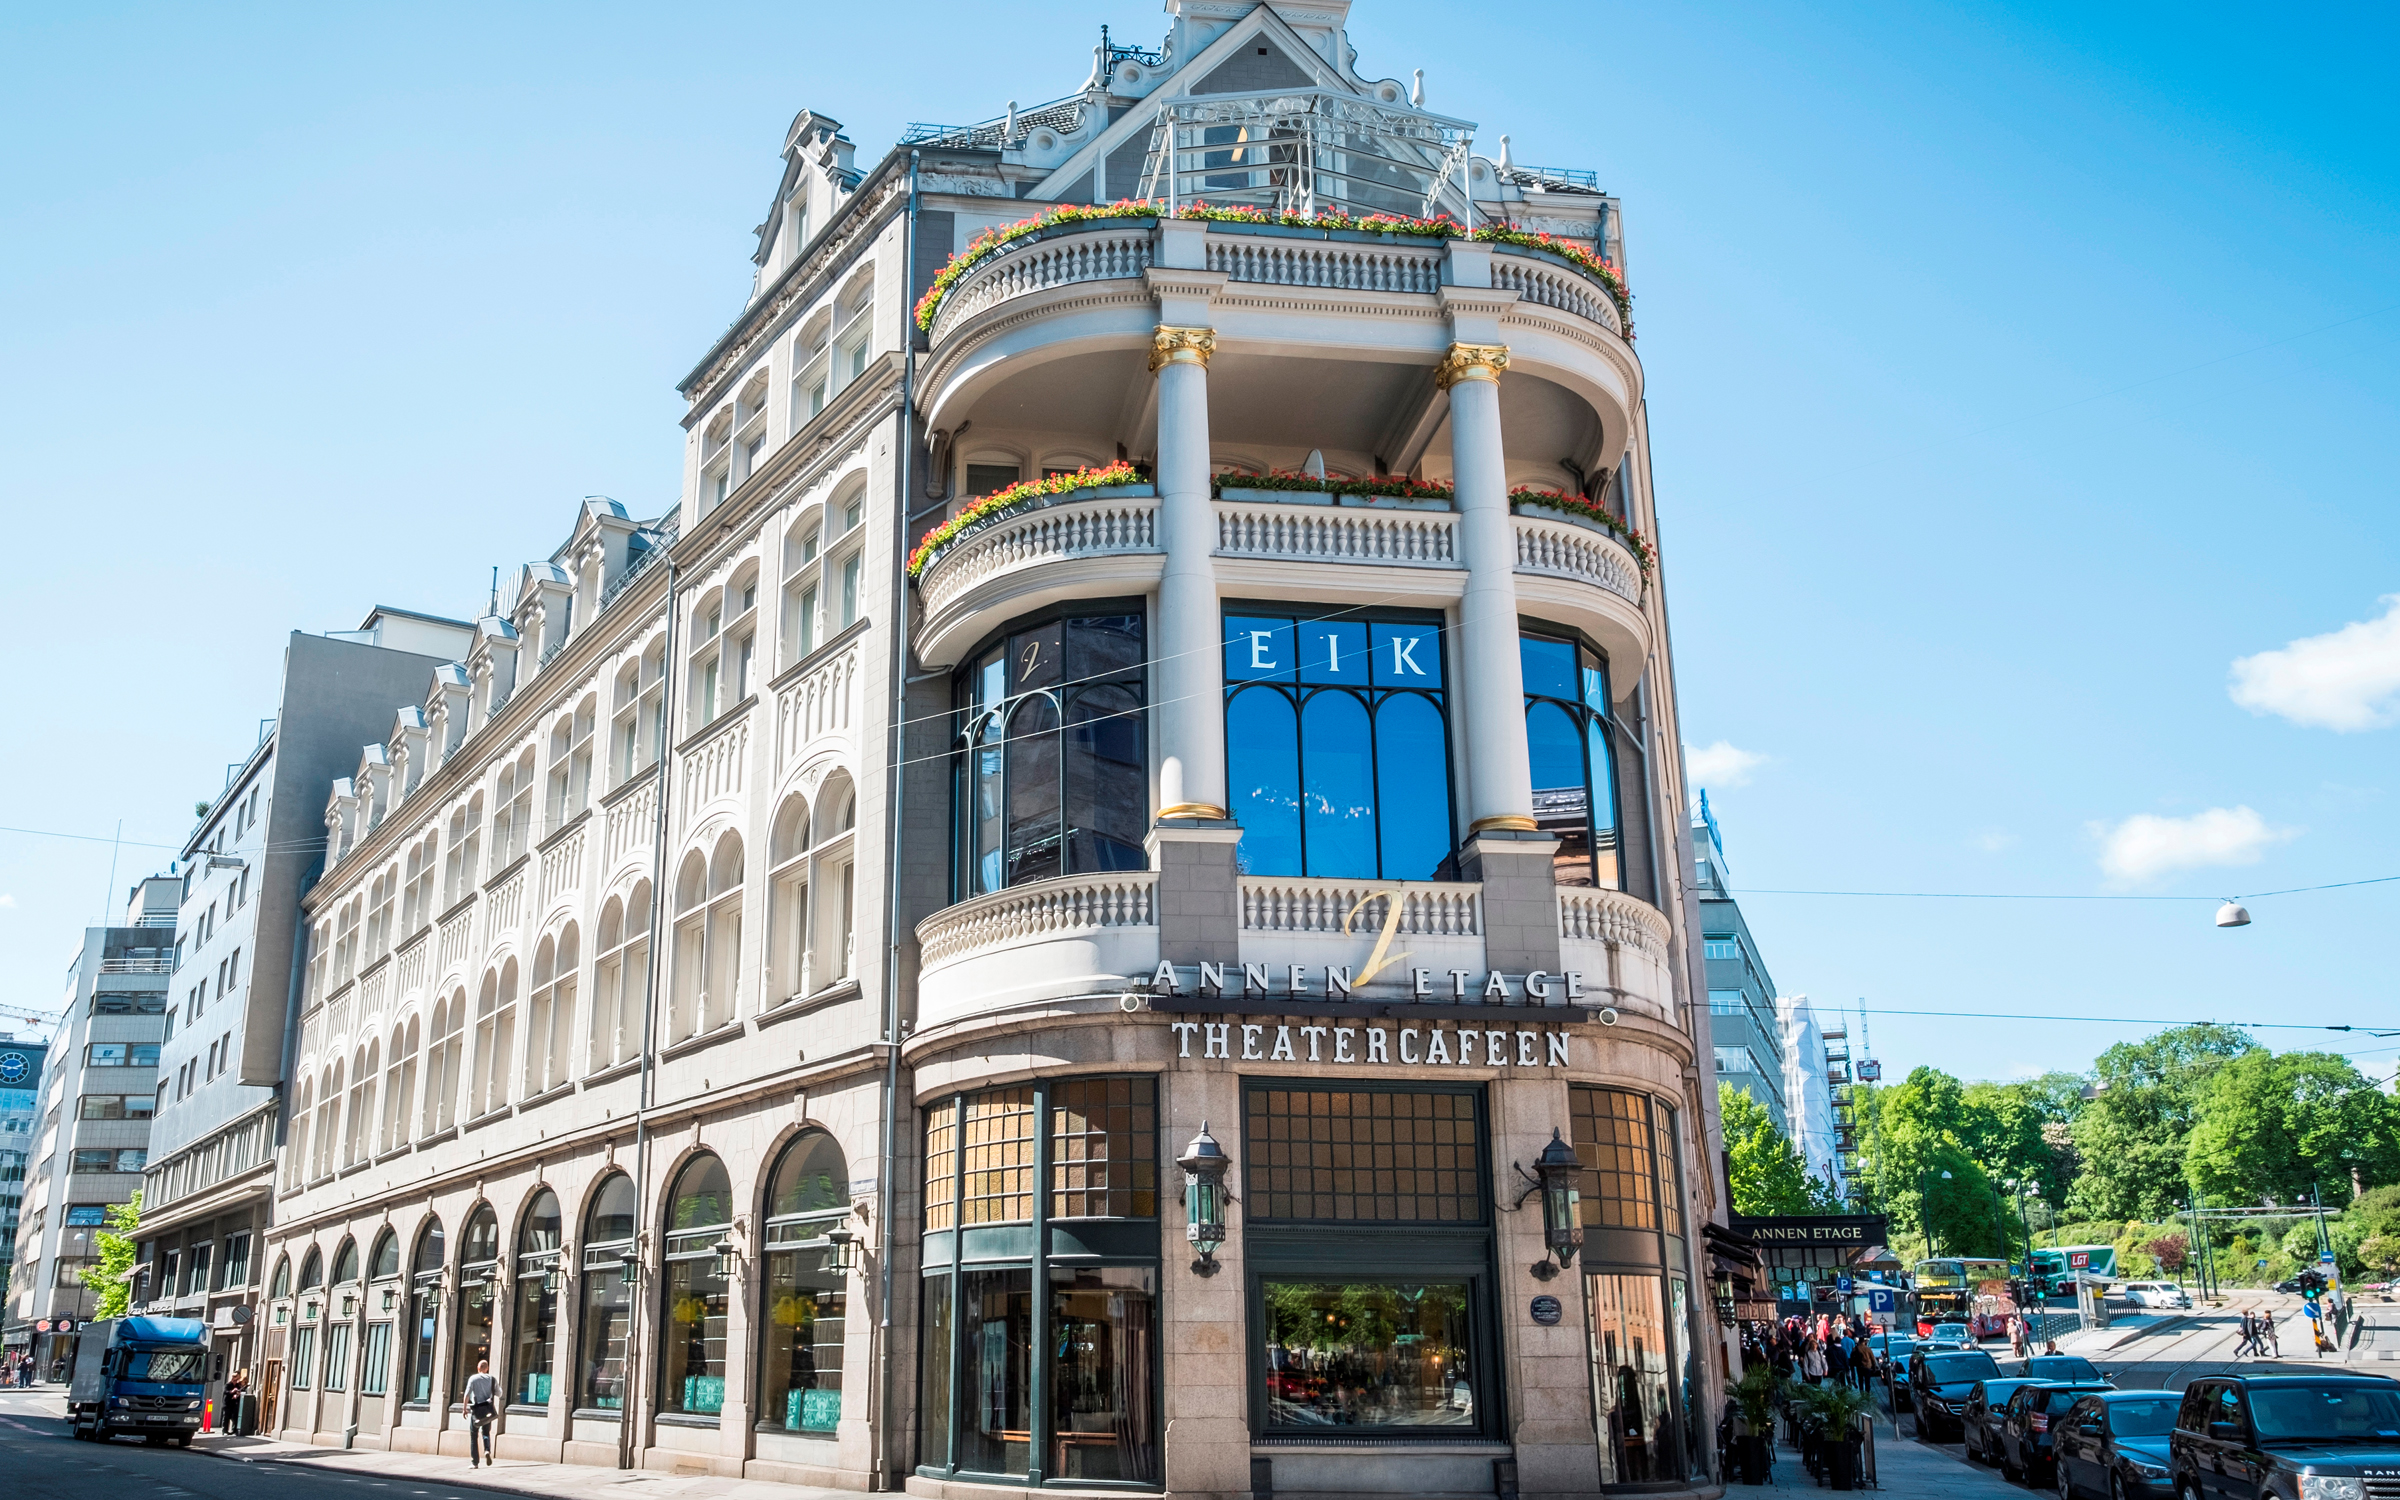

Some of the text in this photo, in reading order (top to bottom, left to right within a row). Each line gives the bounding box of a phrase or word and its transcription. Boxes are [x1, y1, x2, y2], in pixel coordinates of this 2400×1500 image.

[1250, 630, 1427, 676] EIK
[1151, 890, 1586, 999] ANNEN 2 ETAGE
[1171, 1021, 1570, 1067] THEATERCAFEEN
[1752, 1227, 1862, 1240] ANNEN ETAGE
[2072, 1255, 2088, 1265] LGT
[1841, 1279, 1848, 1288] P
[1874, 1292, 1887, 1310] P
